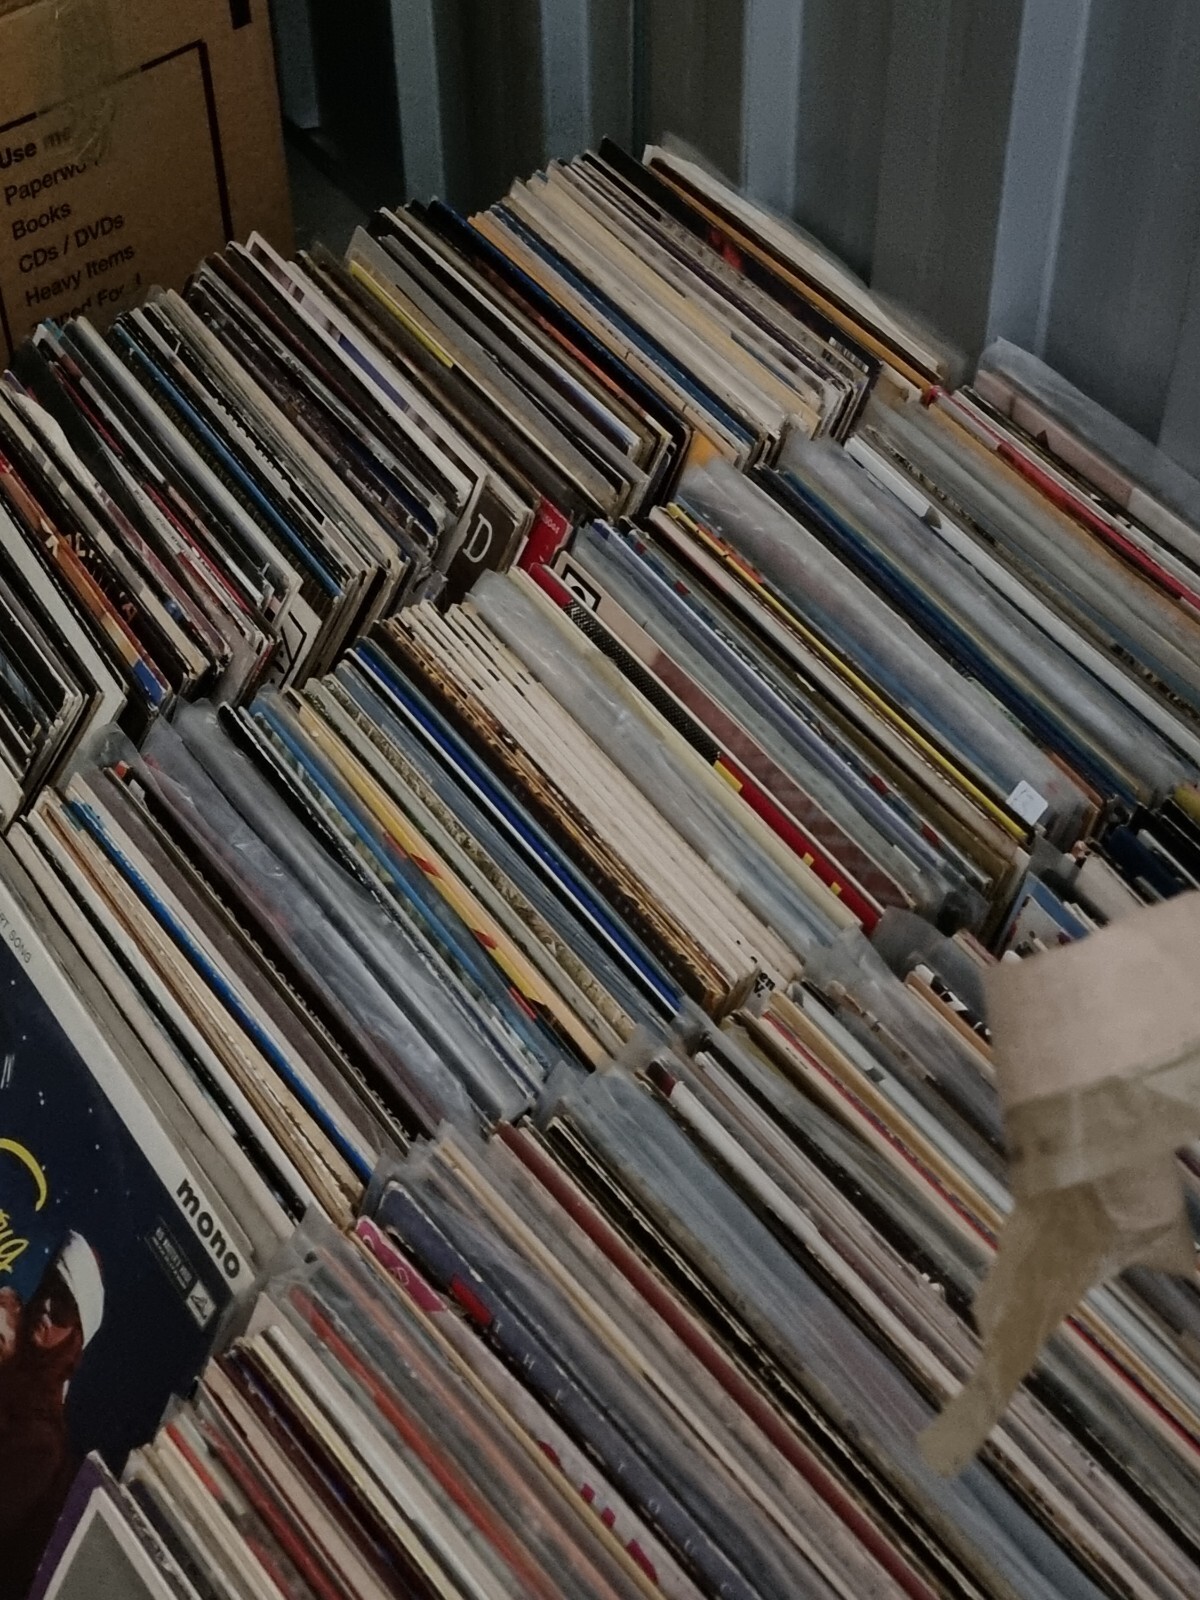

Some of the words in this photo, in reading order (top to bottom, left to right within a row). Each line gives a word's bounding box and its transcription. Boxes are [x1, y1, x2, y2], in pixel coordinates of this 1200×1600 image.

[0, 142, 37, 169] Use
[11, 202, 72, 240] Books
[19, 243, 59, 274] CDs
[63, 234, 70, 256] /
[74, 213, 125, 249] DVDs
[25, 270, 81, 307] Heavy
[86, 244, 135, 280] Items
[463, 513, 493, 563] D
[9, 929, 32, 963] SONG
[176, 1178, 240, 1279] mono
